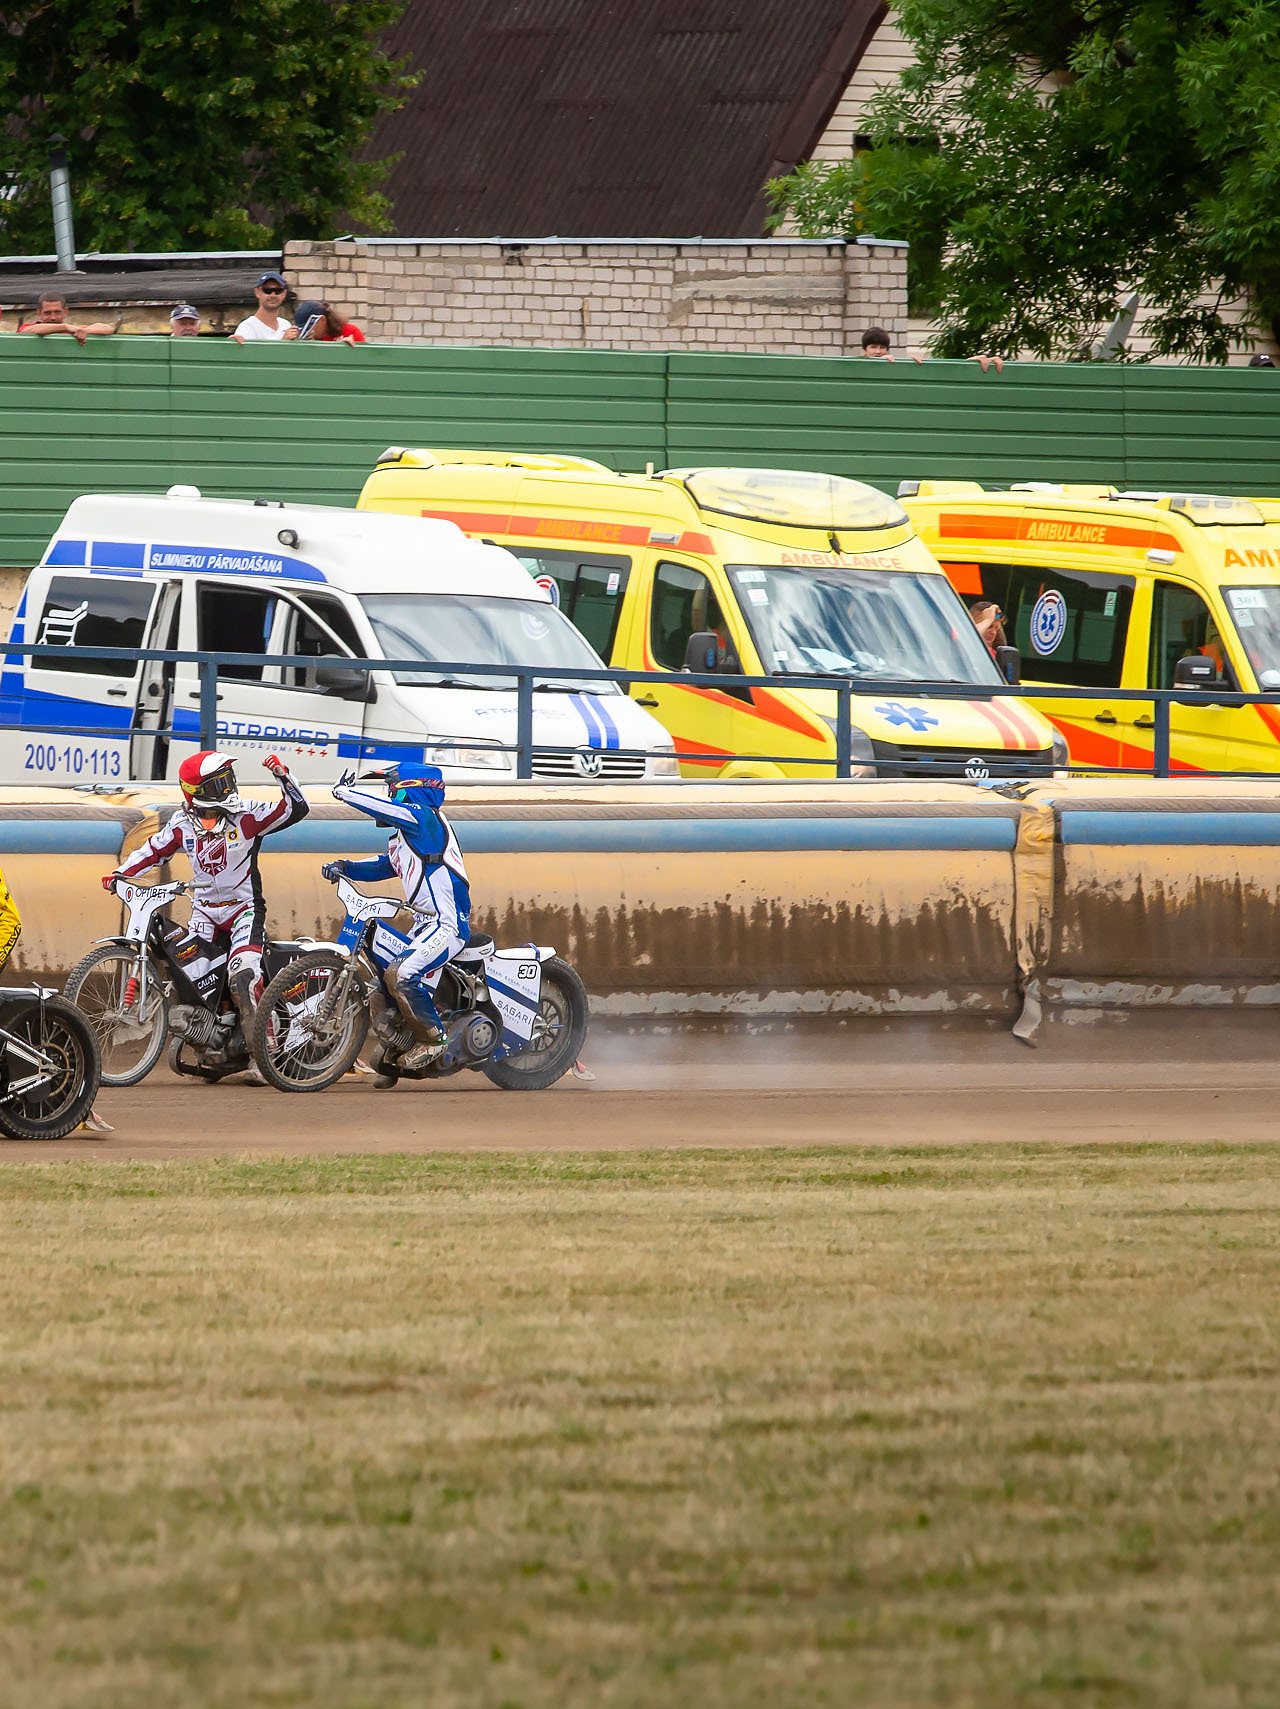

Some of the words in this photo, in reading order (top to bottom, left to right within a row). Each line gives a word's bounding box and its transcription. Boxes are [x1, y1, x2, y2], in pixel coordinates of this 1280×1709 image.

[535, 519, 622, 541] AMBULANCE
[1026, 521, 1107, 543] AMBULANCE
[150, 553, 205, 569] SLIMNIEKU
[781, 553, 905, 569] AMBULANCE
[1224, 548, 1280, 567] AM
[345, 894, 382, 915] SAGARI
[380, 931, 409, 953] SAGAR
[421, 927, 452, 958] SAGAR
[517, 964, 538, 980] 30
[496, 1000, 533, 1025] SAGARI
